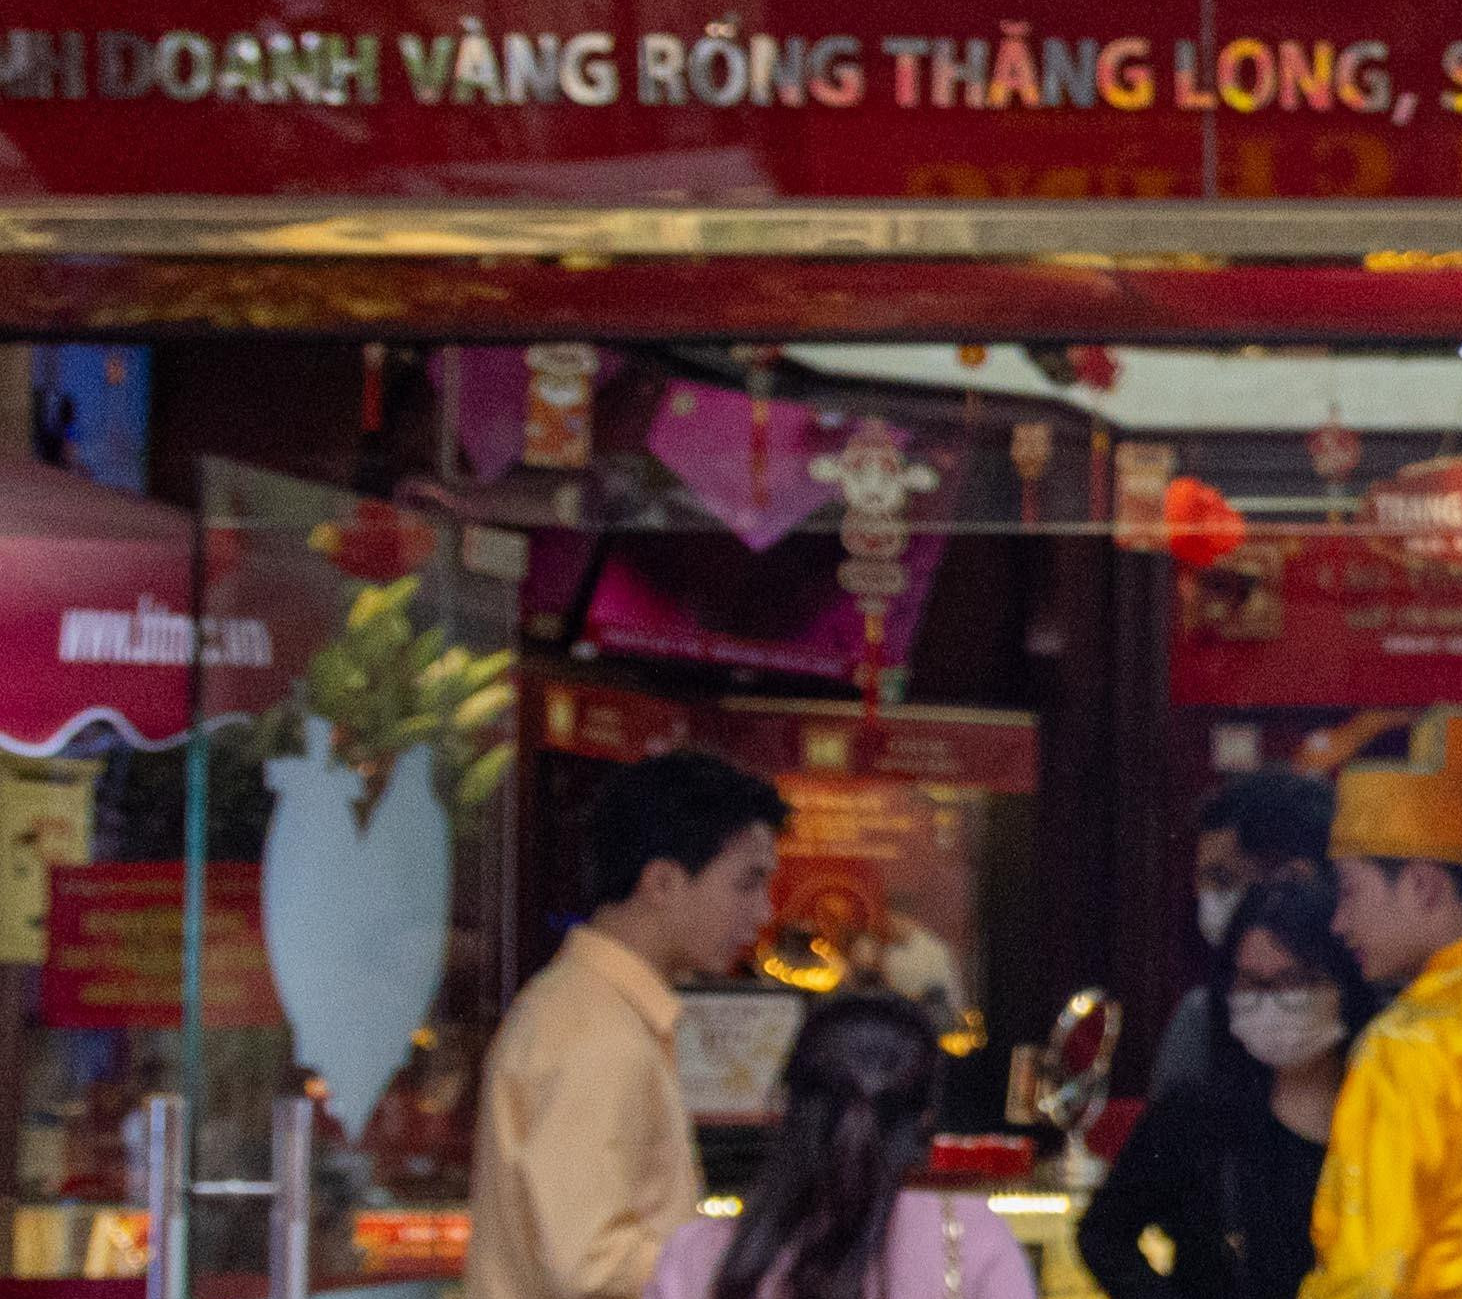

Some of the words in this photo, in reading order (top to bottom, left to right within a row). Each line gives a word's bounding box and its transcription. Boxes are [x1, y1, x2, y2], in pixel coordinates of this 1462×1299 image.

[98, 28, 380, 105] DOANH
[401, 17, 617, 106] VÀNG
[637, 14, 864, 107] RỒNG
[883, 20, 1154, 108] THĂNG
[1174, 38, 1419, 125] LONG,
